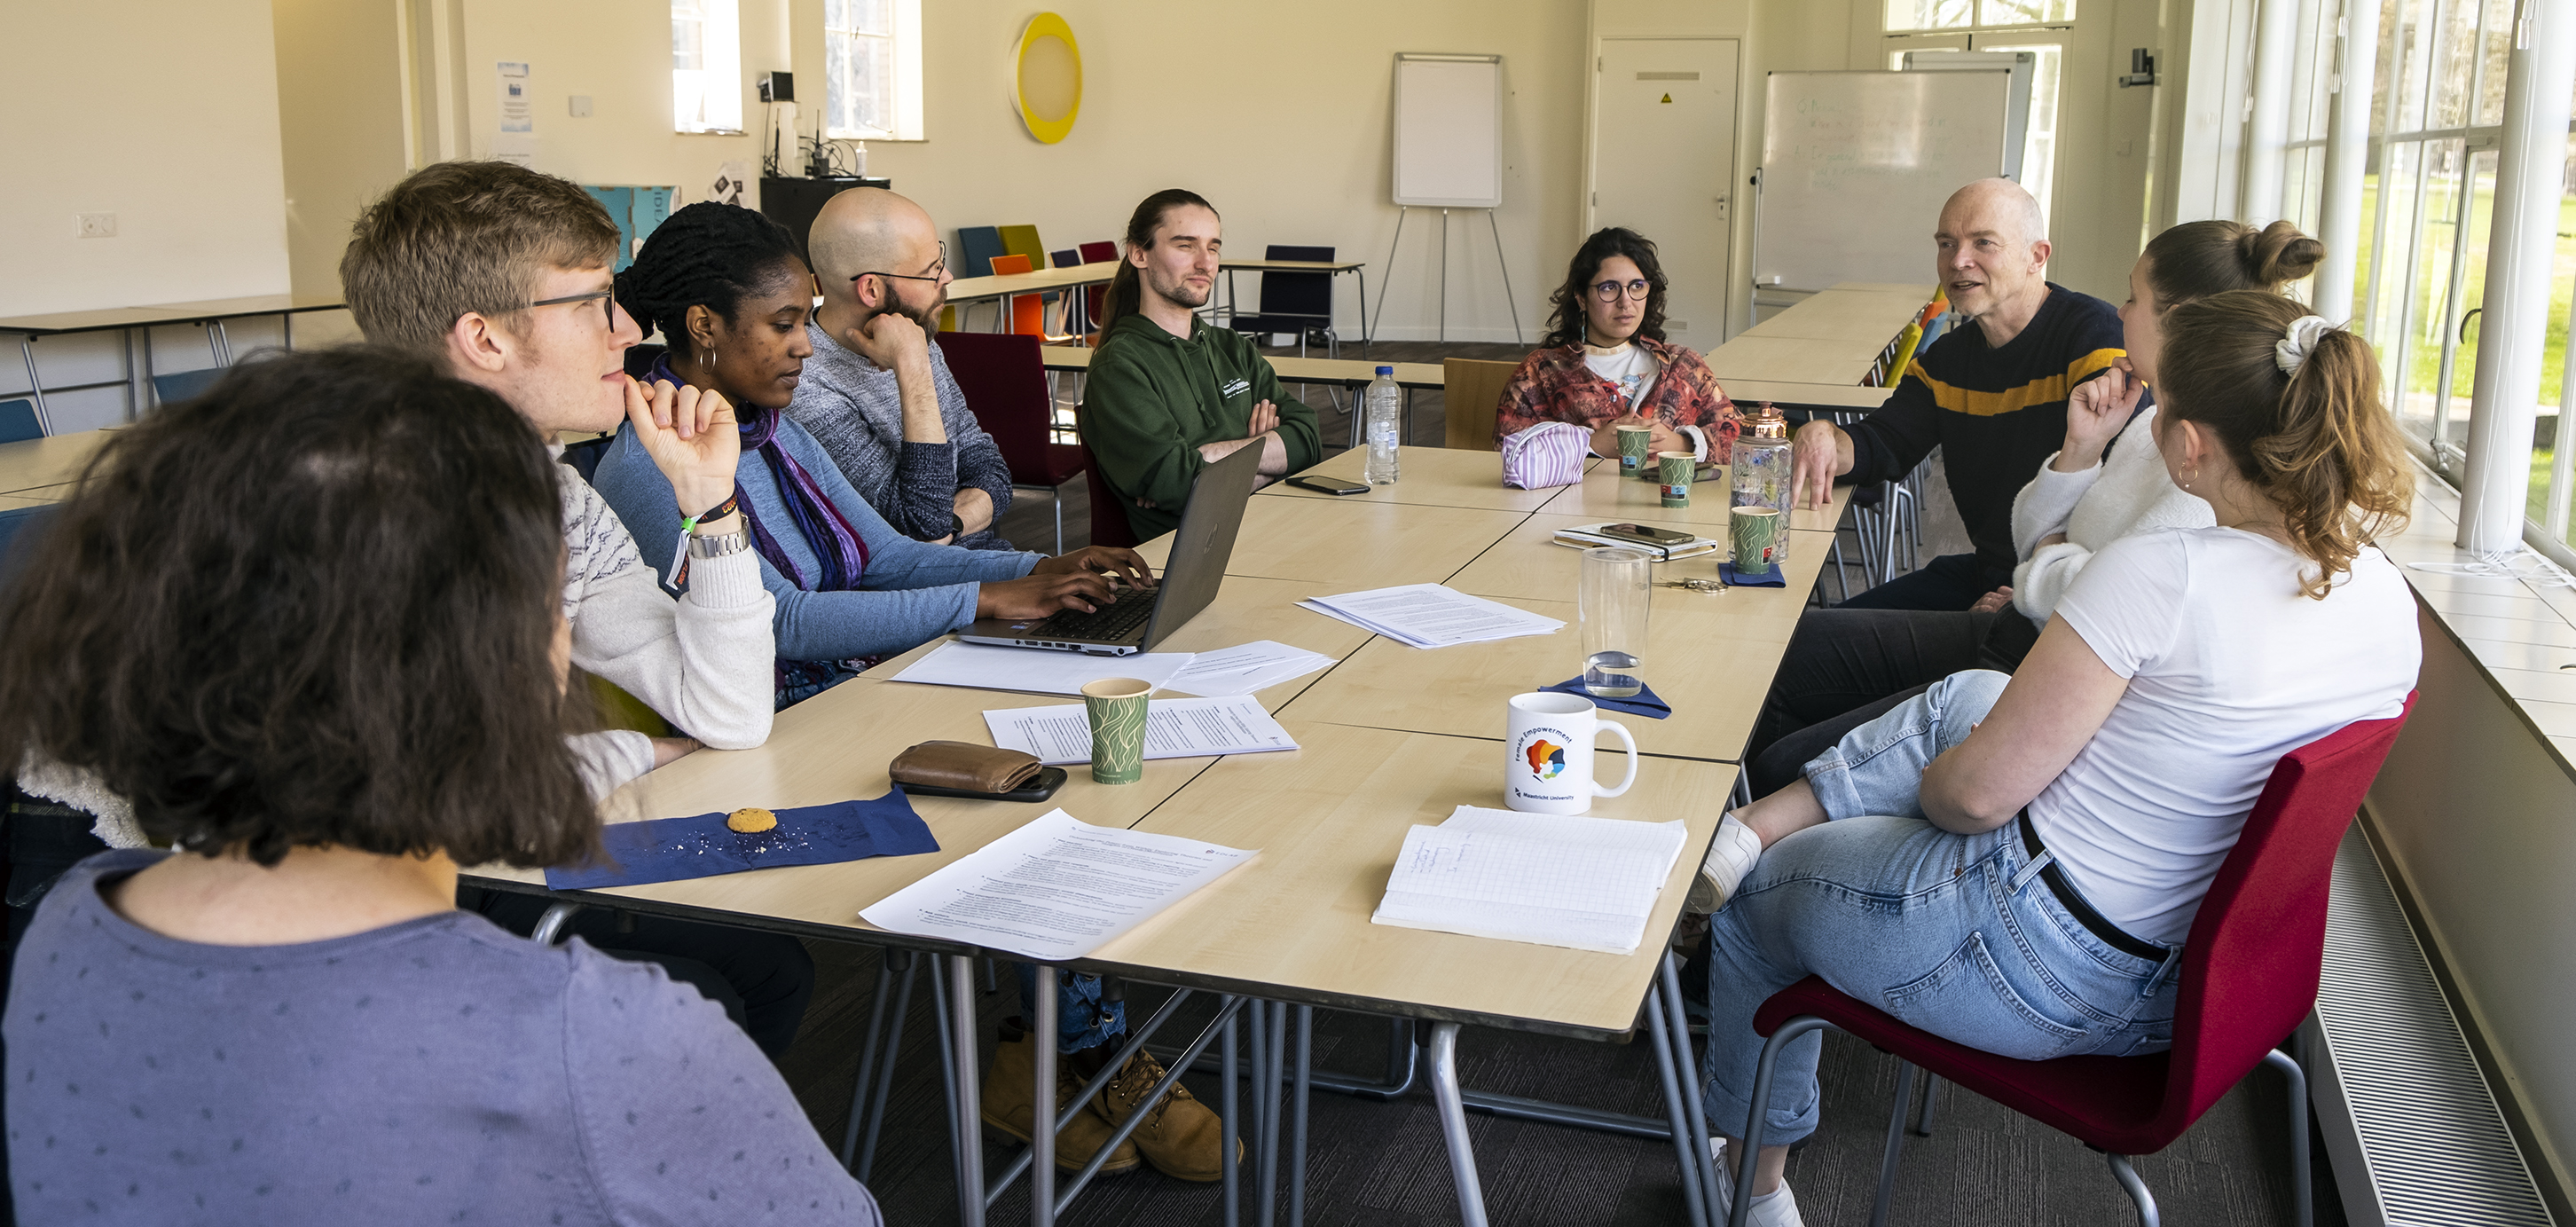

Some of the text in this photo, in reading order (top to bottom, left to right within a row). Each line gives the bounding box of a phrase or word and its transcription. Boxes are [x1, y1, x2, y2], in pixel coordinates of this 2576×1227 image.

[1515, 728, 1572, 762] Female Empowerment
[1523, 791, 1549, 800] Maastricht
